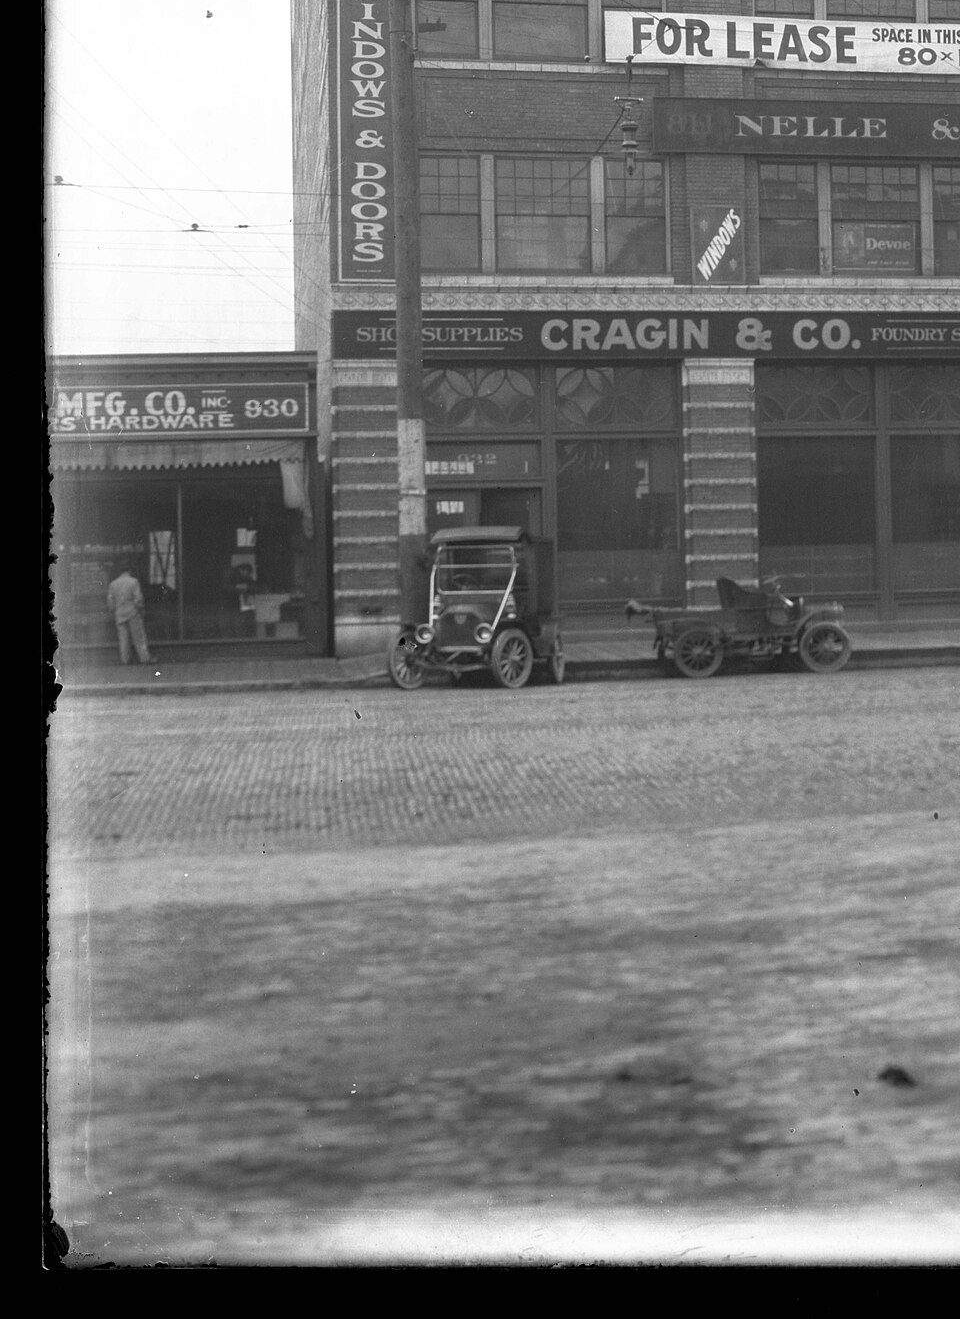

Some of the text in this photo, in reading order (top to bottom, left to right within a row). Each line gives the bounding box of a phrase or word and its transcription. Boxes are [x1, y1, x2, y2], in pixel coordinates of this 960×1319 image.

[632, 15, 714, 58] FOR
[726, 20, 858, 66] LEASE
[871, 27, 915, 44] SPACE
[918, 28, 932, 45] IN
[354, 129, 386, 149] &
[734, 114, 888, 139] NELLE
[931, 118, 960, 141] &
[350, 161, 388, 264] DOORS
[696, 207, 742, 282] WINDOWS
[865, 237, 912, 251] Devoe
[357, 326, 525, 342] SHO SUPPLIES
[541, 317, 864, 352] CRAGIN & CO.
[870, 327, 949, 342] FOUNDRY
[57, 391, 140, 417] MFG.
[144, 390, 196, 417] CO.
[244, 397, 299, 418] 930
[89, 413, 236, 431] HARDWARE
